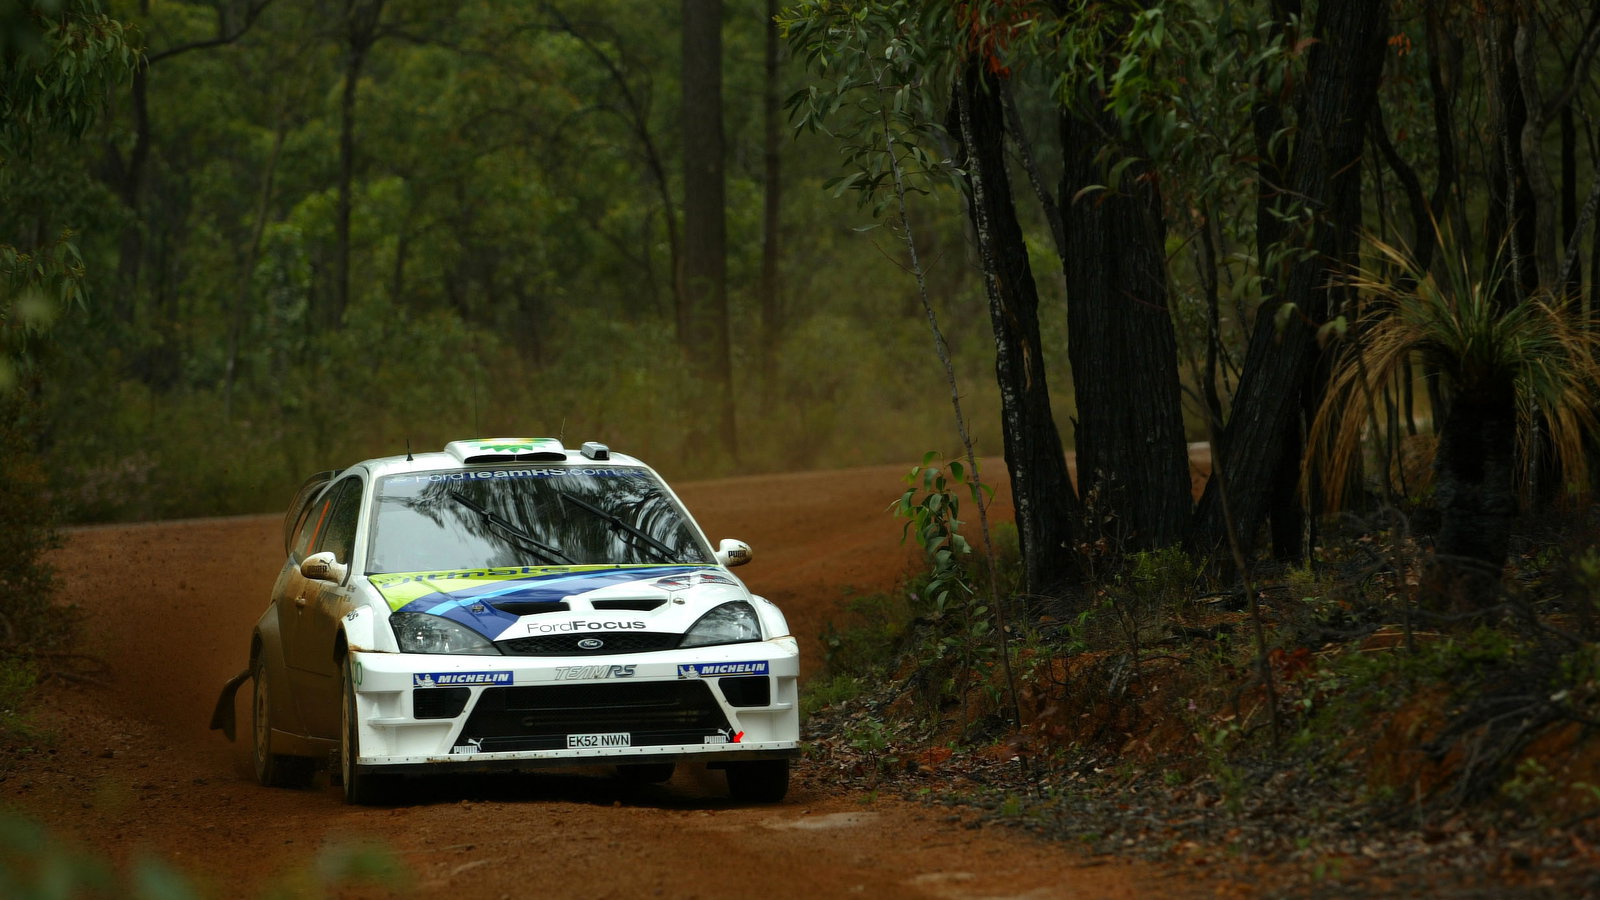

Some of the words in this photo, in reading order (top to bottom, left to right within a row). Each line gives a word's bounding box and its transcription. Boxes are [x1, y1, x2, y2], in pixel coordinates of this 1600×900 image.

[527, 620, 646, 634] FordFocus
[701, 663, 766, 674] MICHELIN
[438, 673, 509, 683] MICHELIN
[569, 735, 599, 747] EK52
[601, 734, 630, 746] NWN
